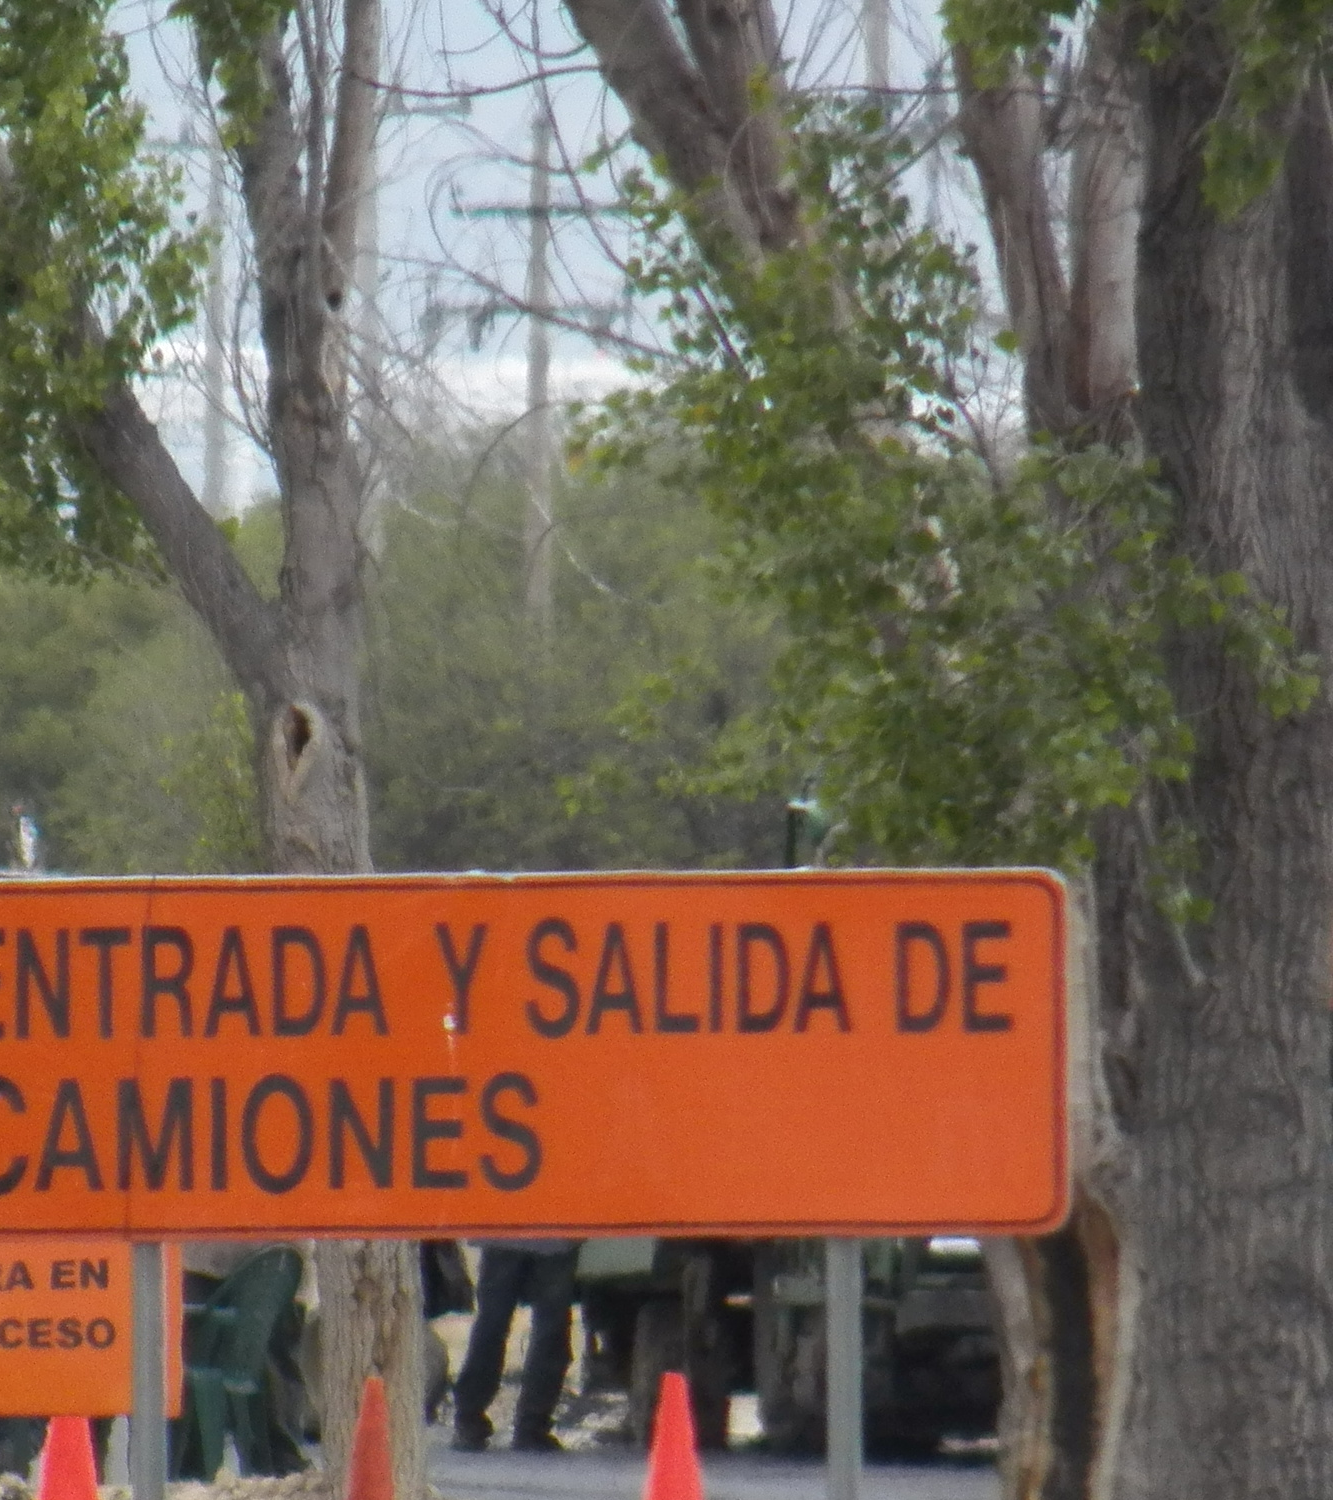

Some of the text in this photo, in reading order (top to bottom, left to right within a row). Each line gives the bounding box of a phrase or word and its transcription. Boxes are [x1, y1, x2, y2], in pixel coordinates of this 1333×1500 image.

[434, 921, 488, 1036] Y
[523, 917, 852, 1040] SALIDA
[894, 919, 1014, 1035] DE
[50, 1259, 109, 1291] EN
